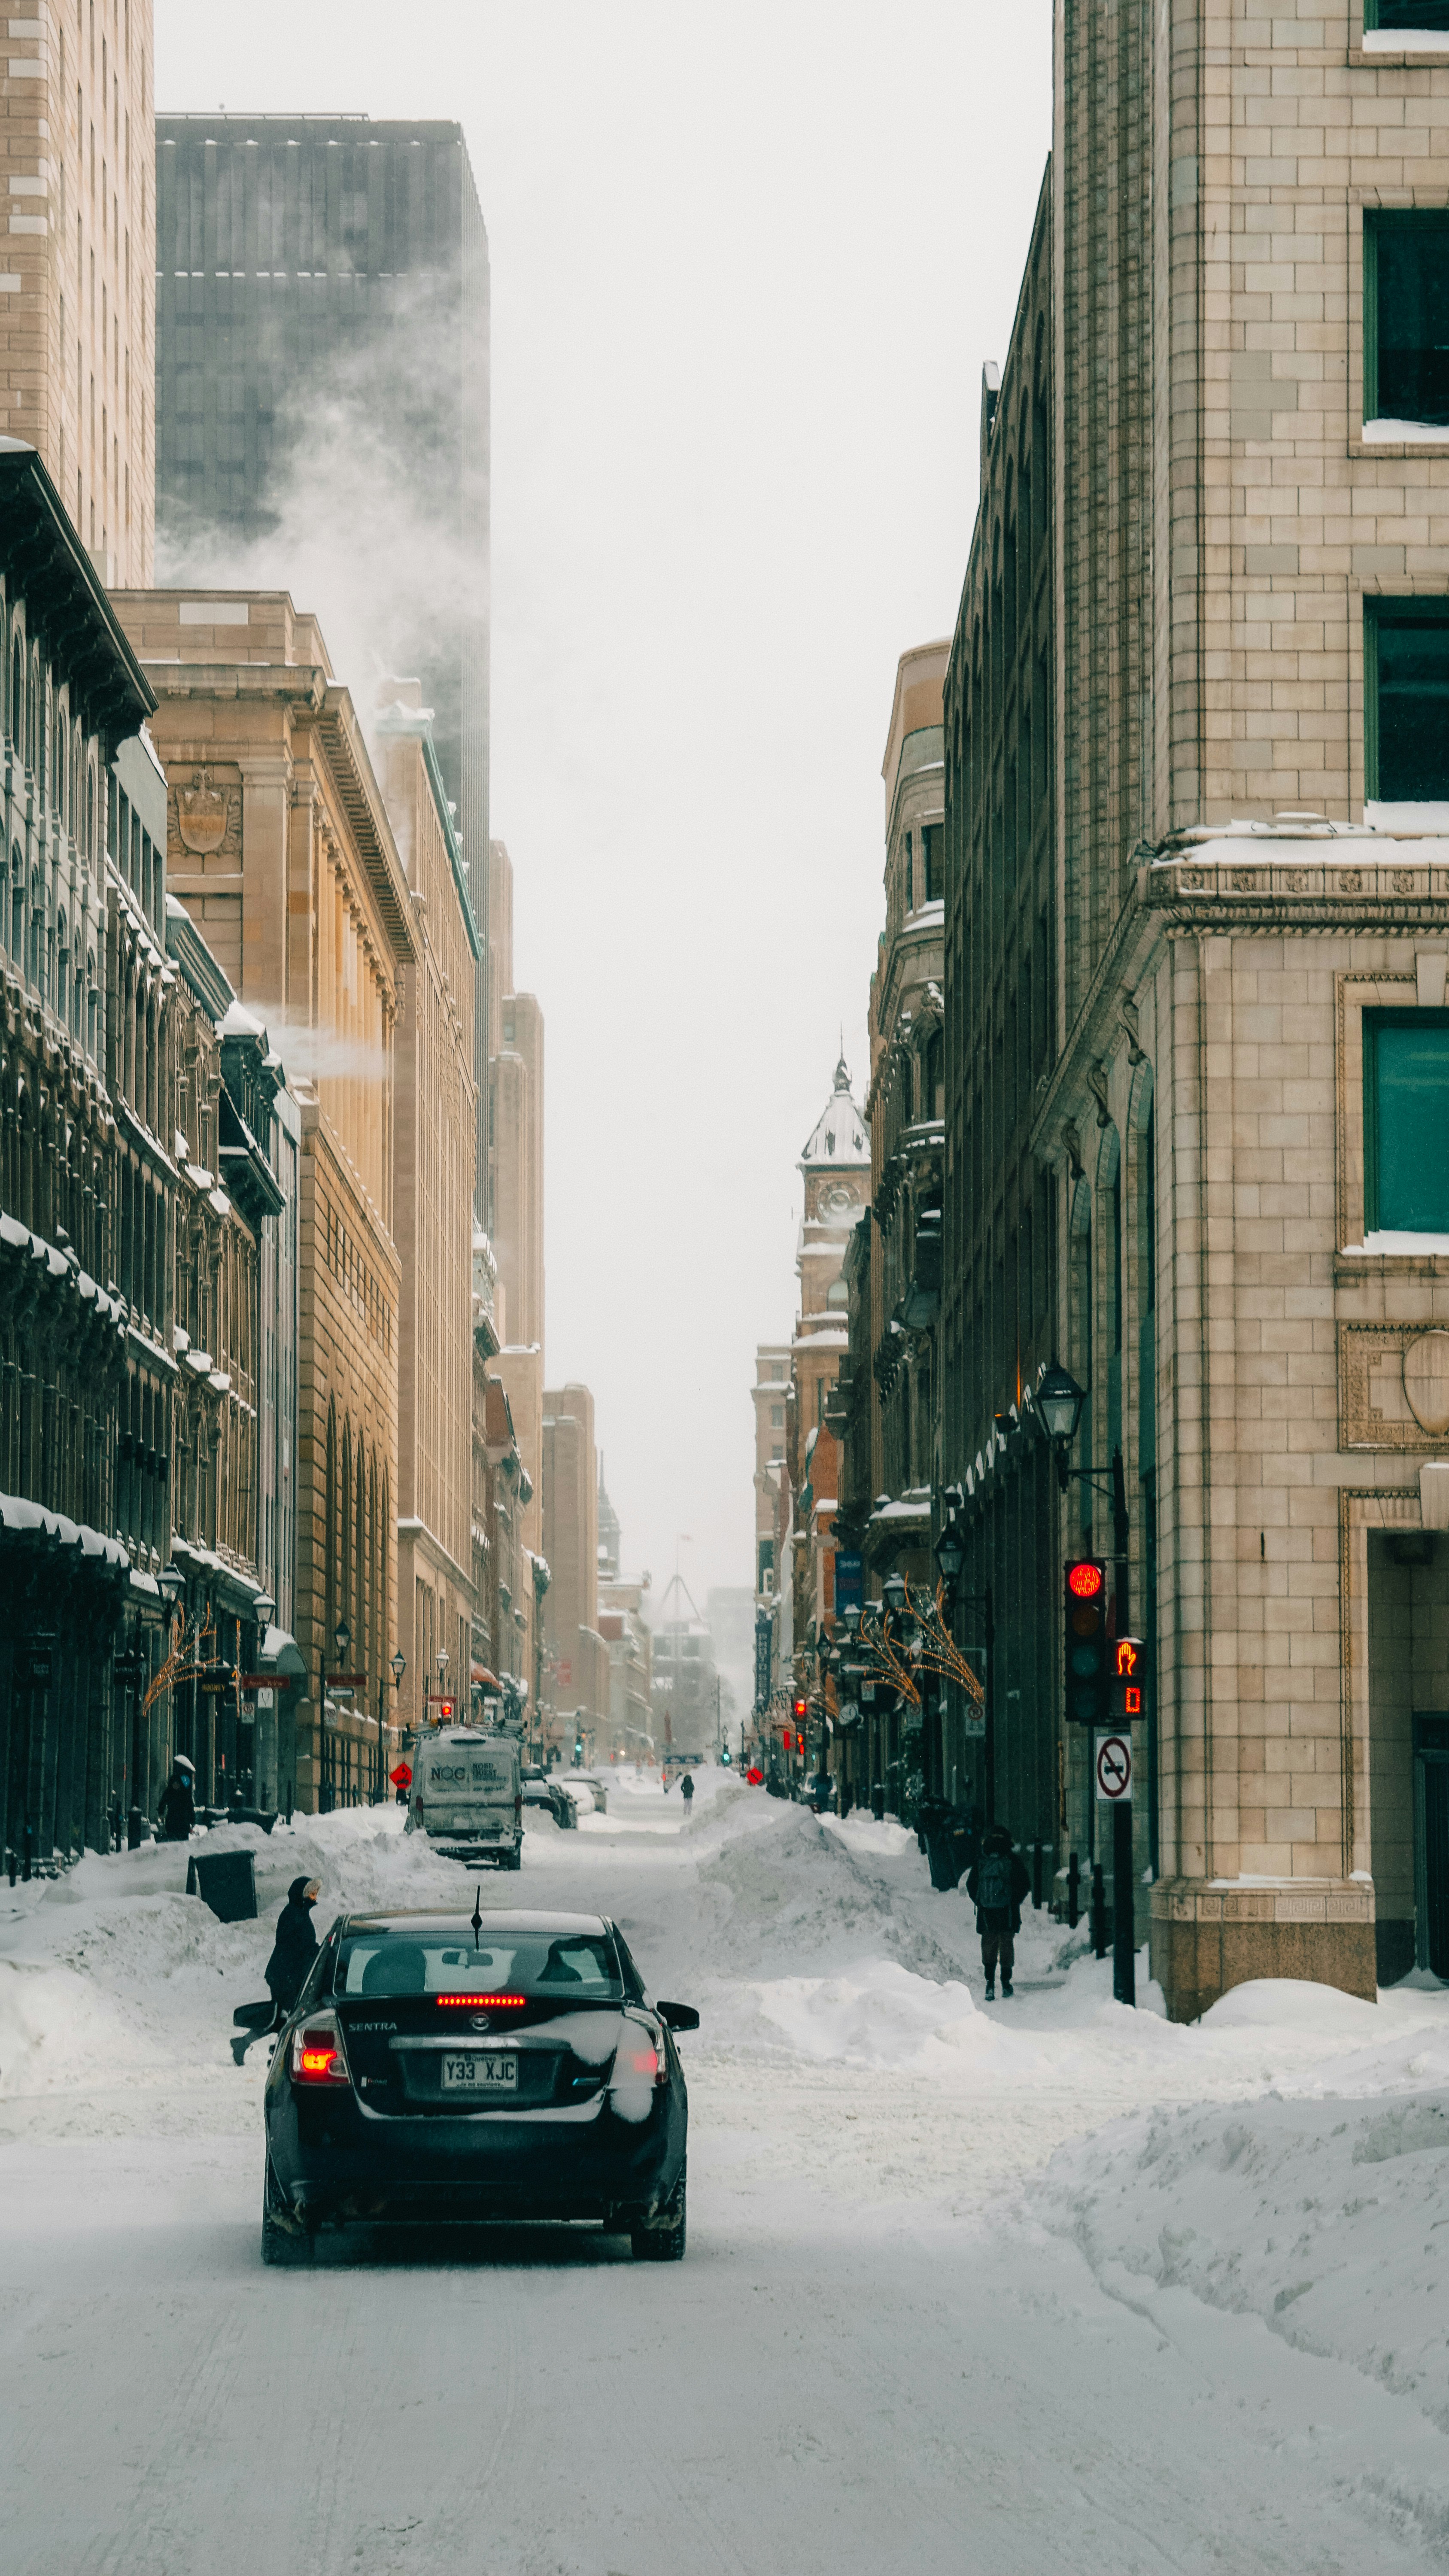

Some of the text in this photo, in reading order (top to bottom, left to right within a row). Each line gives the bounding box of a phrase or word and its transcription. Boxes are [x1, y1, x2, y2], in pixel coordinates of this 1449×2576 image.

[1126, 1687, 1140, 1713] 0
[431, 1765, 465, 1781] NOC
[349, 2022, 397, 2031] SENTRA
[447, 2061, 514, 2080] Y33 XJC
